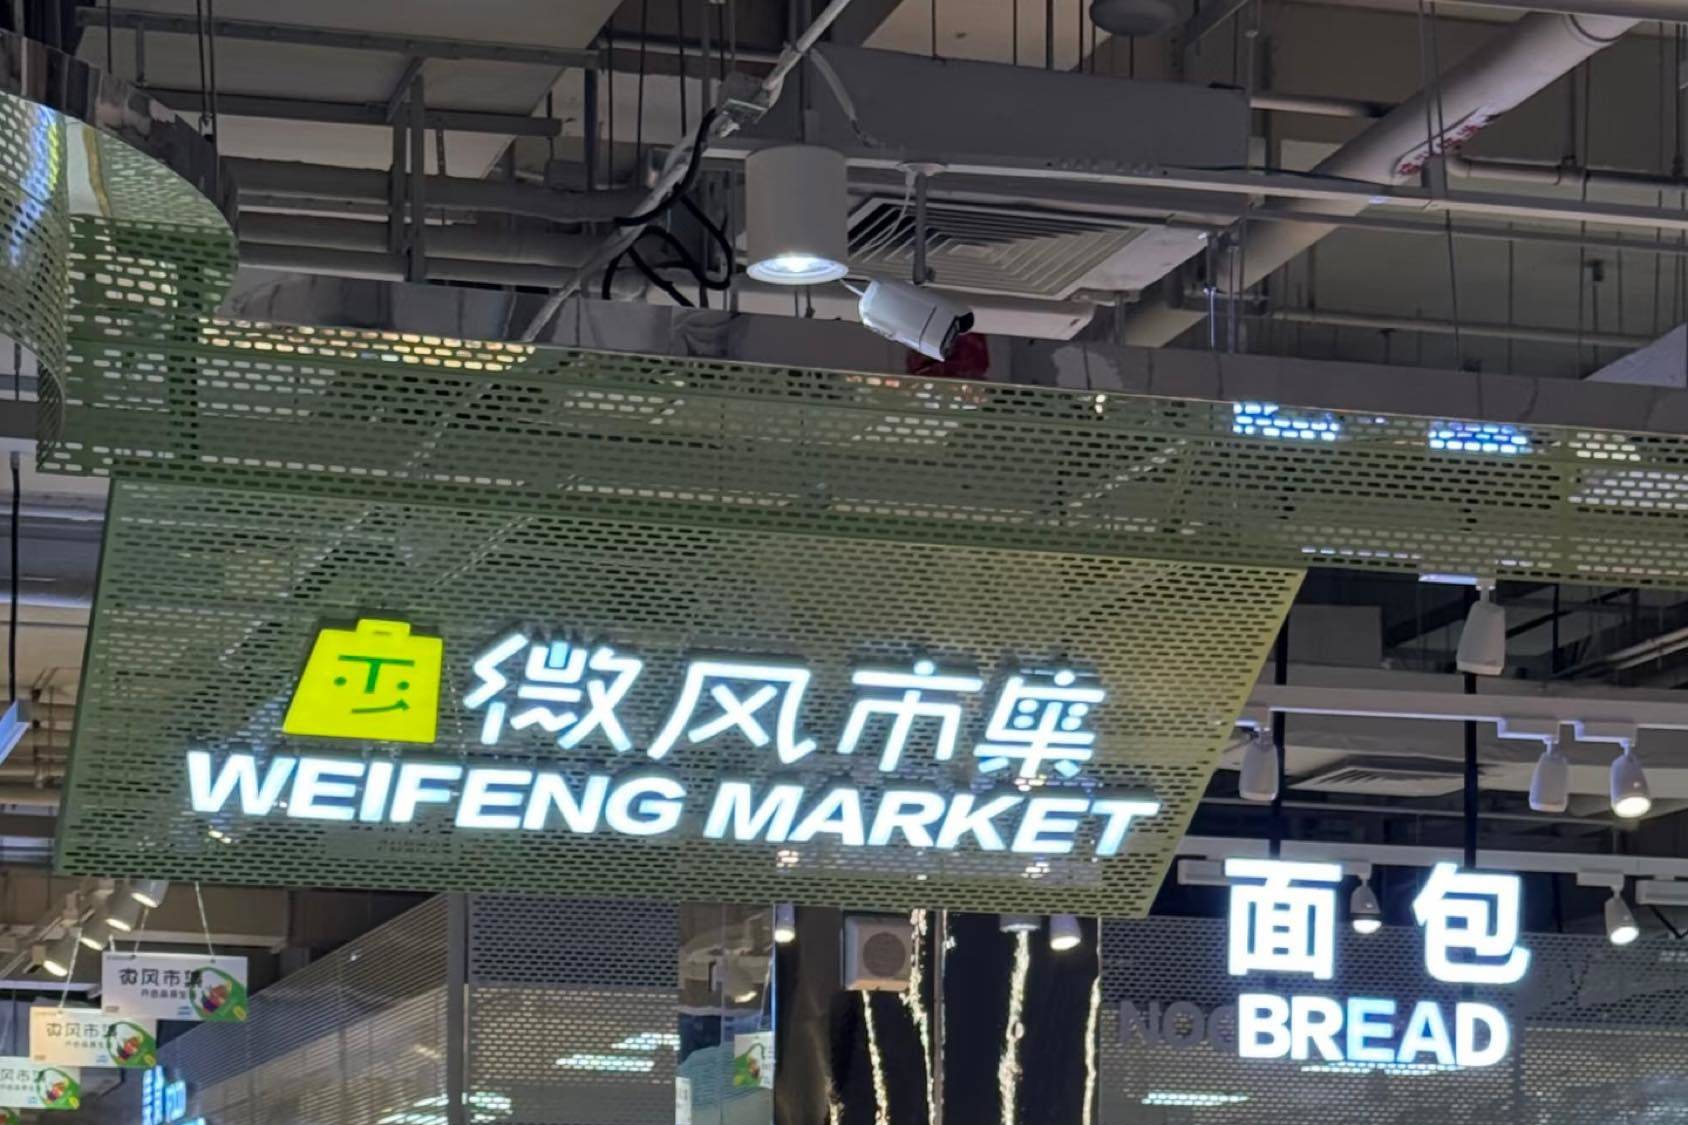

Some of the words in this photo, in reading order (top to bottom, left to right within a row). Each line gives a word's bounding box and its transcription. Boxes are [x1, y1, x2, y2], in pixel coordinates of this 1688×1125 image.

[186, 750, 687, 836] WEIFENG
[702, 781, 1161, 856] MARKET
[1224, 857, 1531, 984] 面包
[1238, 993, 1510, 1067] BREAD
